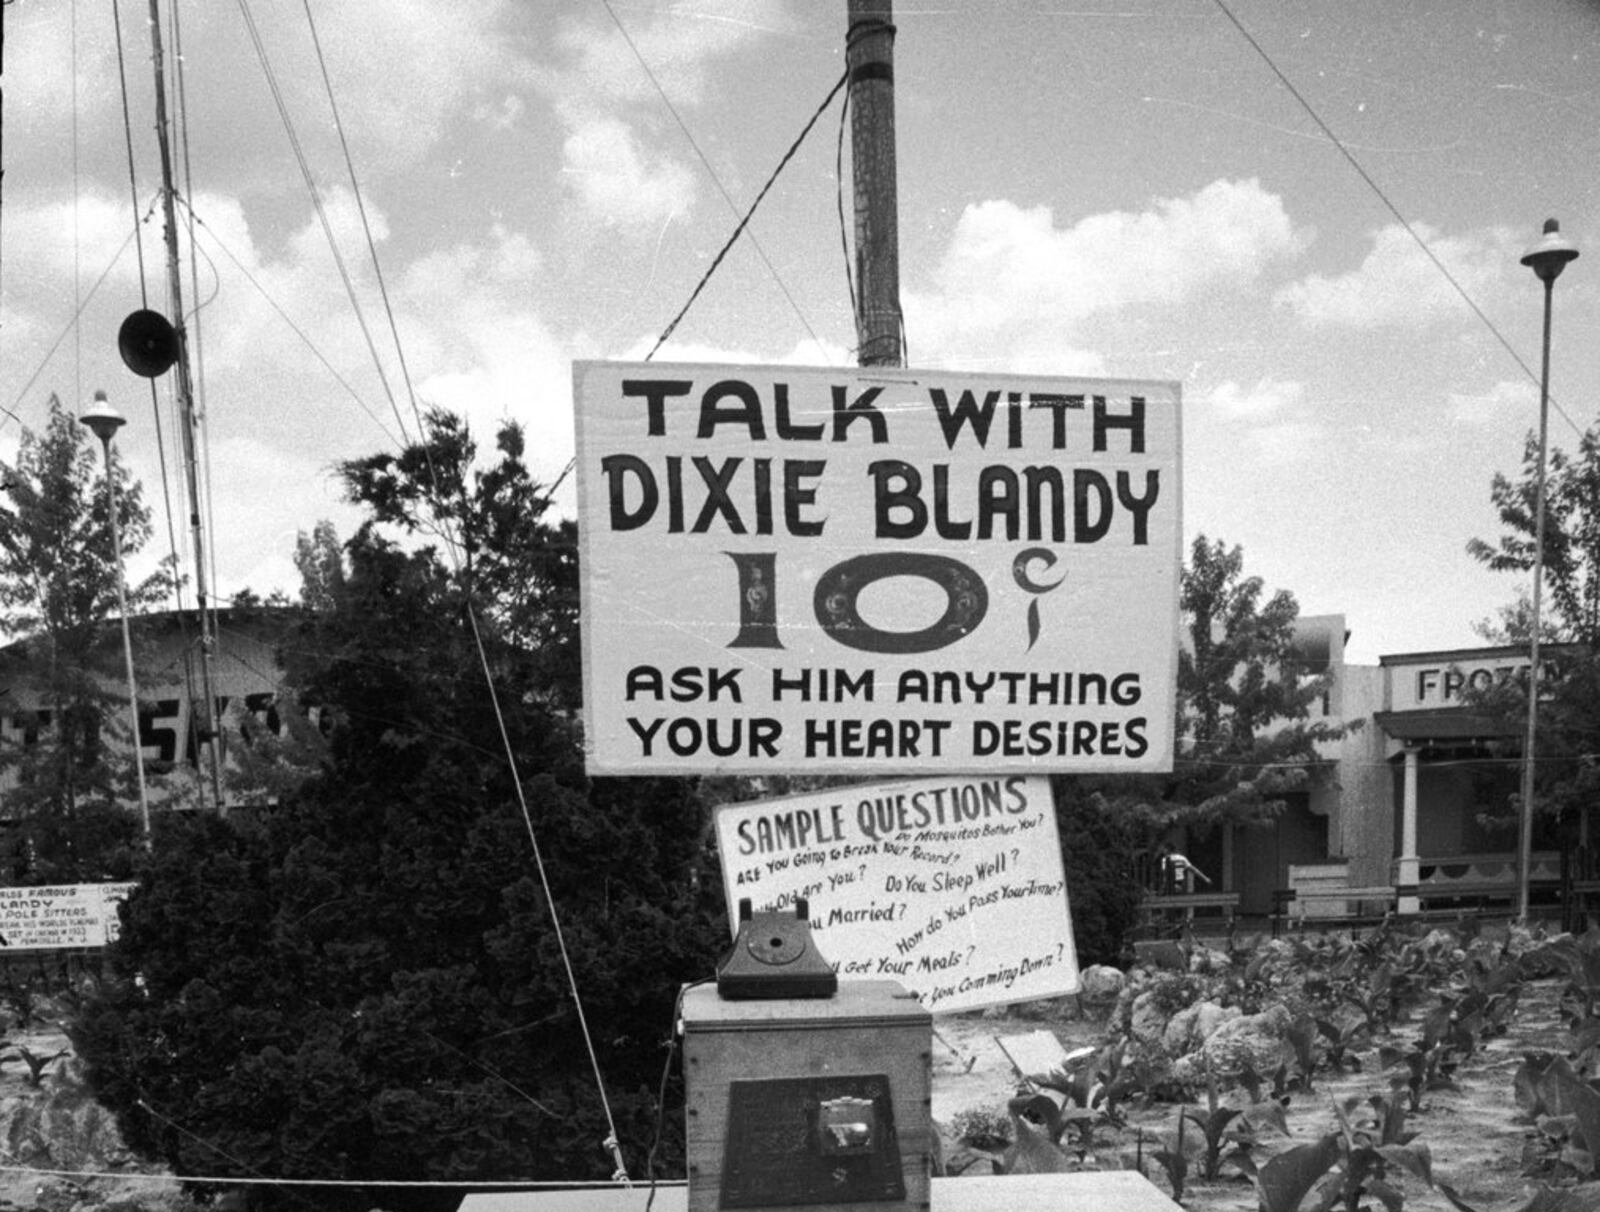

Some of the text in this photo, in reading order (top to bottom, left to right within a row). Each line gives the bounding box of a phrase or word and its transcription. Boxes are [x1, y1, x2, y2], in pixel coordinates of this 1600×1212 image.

[621, 379, 1146, 453] TALK WITH
[601, 454, 1160, 545] DIXIE BLANDY
[721, 547, 1069, 656] 10¢
[626, 666, 1142, 706] ASK HIM ANYTHING
[626, 717, 1149, 759] YOUR HEART DESIRES
[738, 775, 1028, 855] SAMPLE QUESTIONS
[915, 826, 980, 843] Mosquitos
[737, 867, 761, 885] ARE
[793, 847, 826, 868] Going
[886, 874, 901, 893] Do
[902, 874, 926, 893] You
[931, 871, 974, 894] Sleep
[28, 888, 77, 897] FAMOUS
[777, 889, 798, 909] Old
[6, 907, 87, 919] POLE SITTERS
[896, 927, 923, 955] How
[926, 916, 943, 936] do
[944, 905, 967, 923] You
[969, 890, 999, 912] Pass
[840, 958, 872, 974] Get
[876, 955, 914, 976] Your
